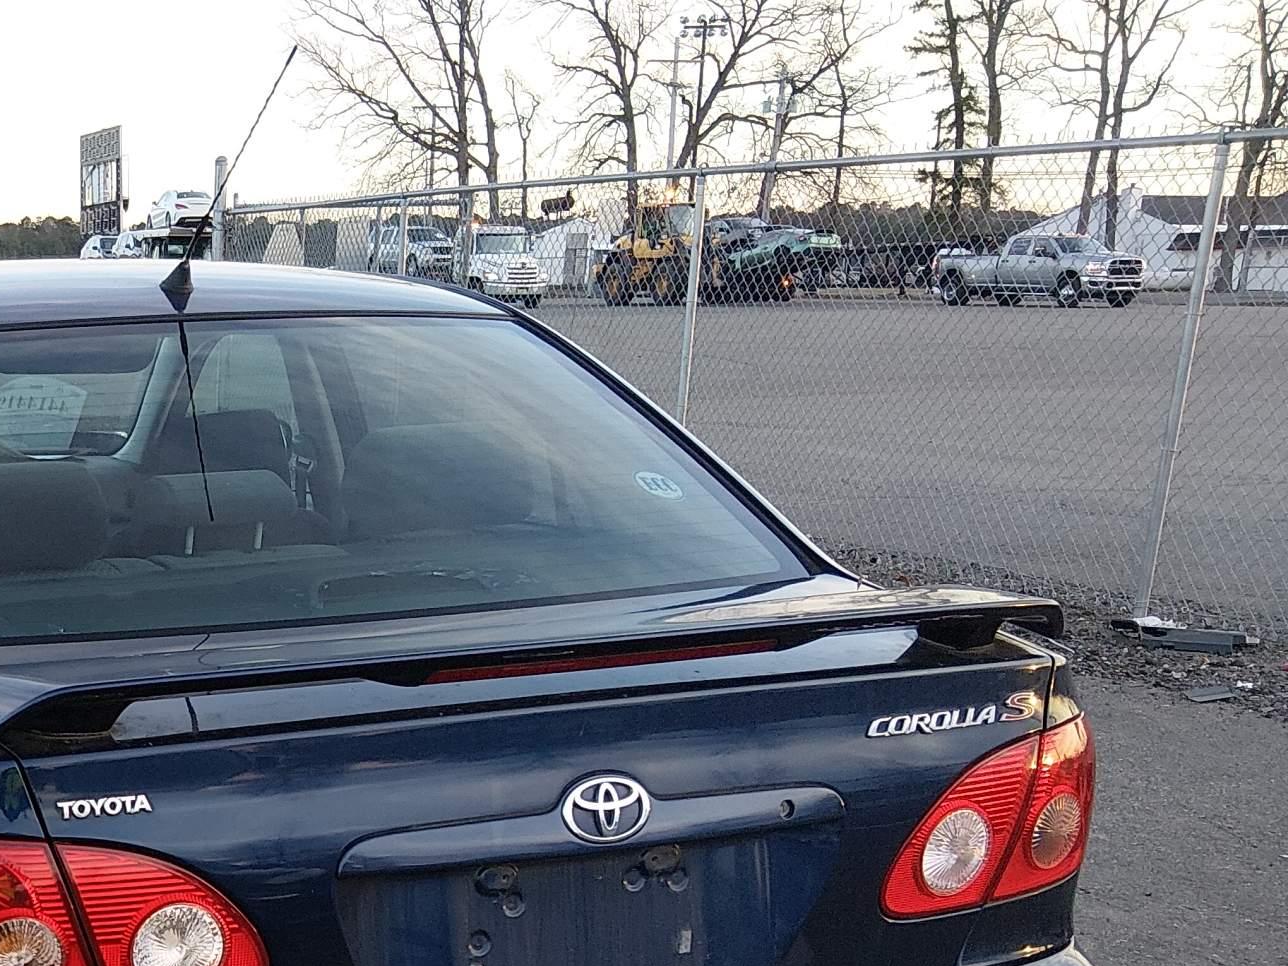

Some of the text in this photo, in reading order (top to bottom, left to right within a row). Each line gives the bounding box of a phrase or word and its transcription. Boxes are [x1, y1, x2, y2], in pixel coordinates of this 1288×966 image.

[867, 691, 1035, 737] COROLLA S
[56, 794, 153, 820] TOYOTA
